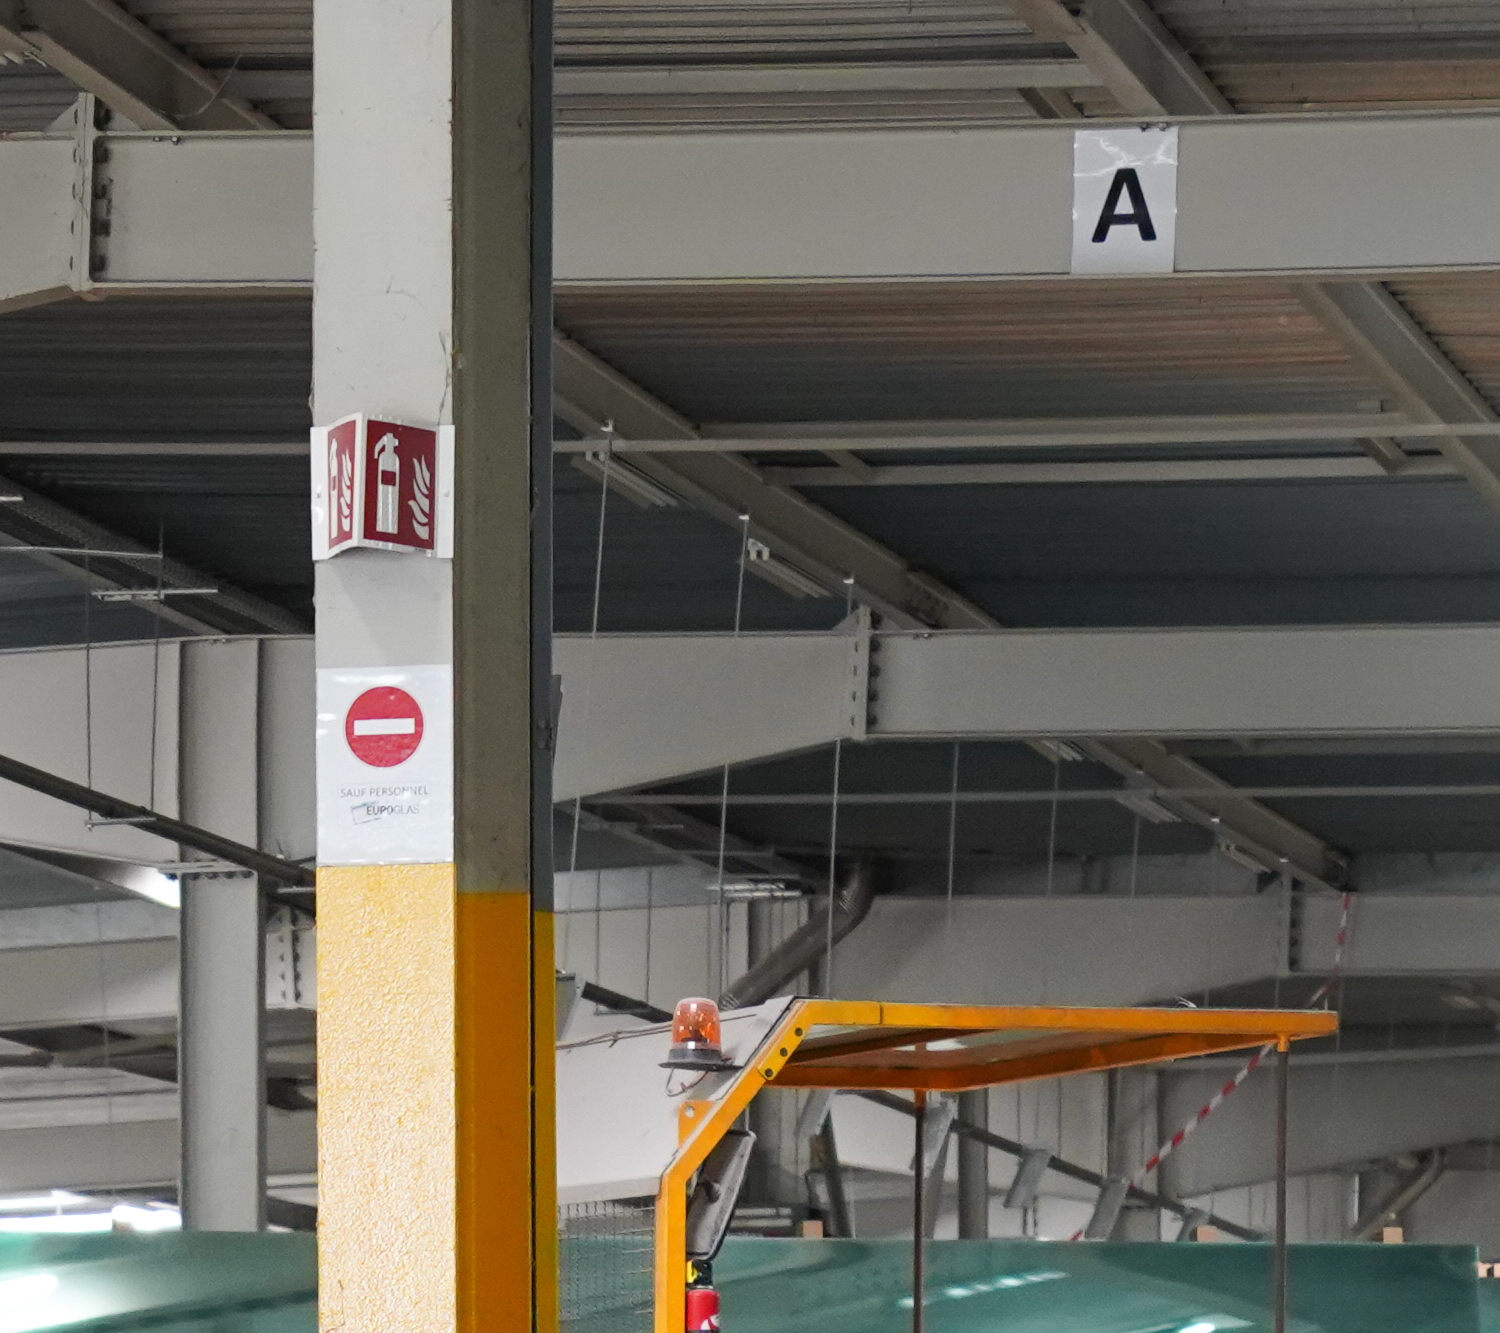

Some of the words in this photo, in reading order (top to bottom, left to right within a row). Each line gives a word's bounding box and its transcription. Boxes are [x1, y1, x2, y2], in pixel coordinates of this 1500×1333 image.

[1091, 166, 1159, 244] A
[340, 787, 367, 799] SAUF
[369, 785, 430, 799] PERSONNEL
